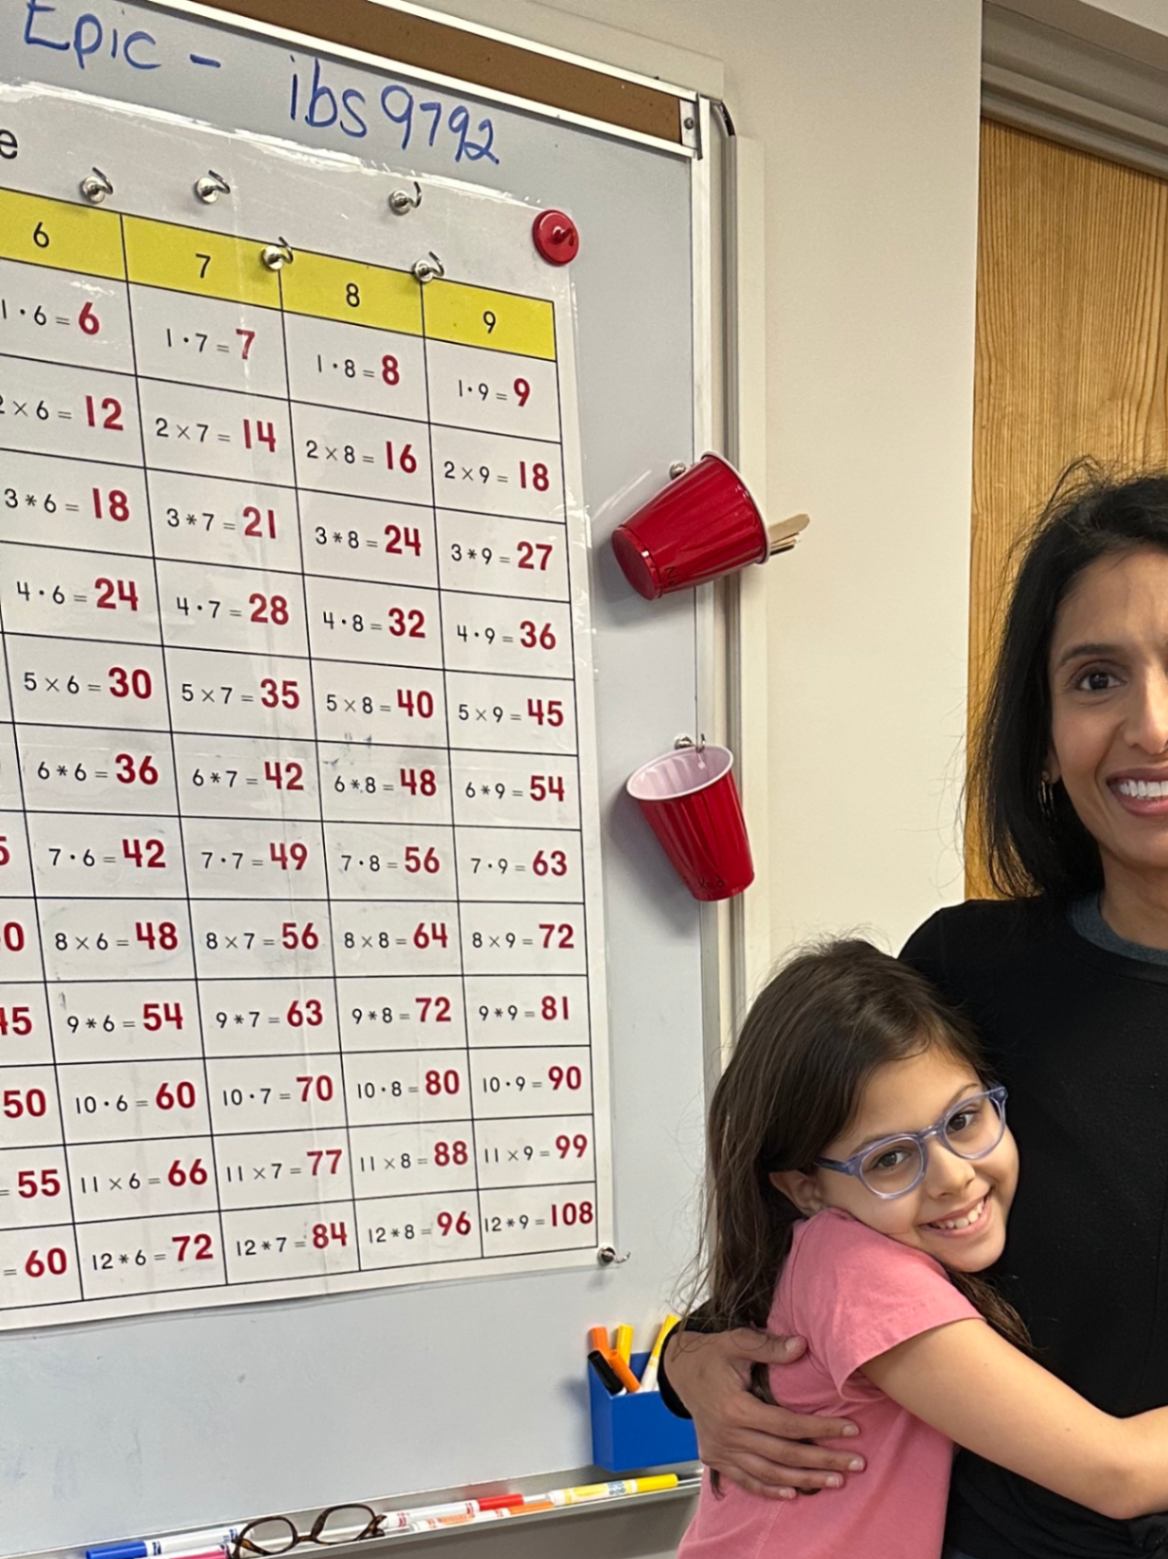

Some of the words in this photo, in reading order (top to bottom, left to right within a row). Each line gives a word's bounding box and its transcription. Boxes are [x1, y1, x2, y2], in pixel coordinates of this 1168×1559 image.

[33, 222, 50, 249] 6
[194, 253, 212, 280] 7
[345, 282, 361, 309] 8
[482, 310, 498, 335] 9
[235, 327, 257, 361] 7
[513, 377, 531, 406] 9
[243, 421, 276, 450] 14
[520, 463, 550, 493] 18
[243, 506, 276, 538] 21
[517, 541, 553, 570] 27
[249, 592, 289, 625] 28
[521, 620, 557, 650] 36
[261, 678, 300, 710] 35
[527, 699, 564, 728] 45
[264, 762, 303, 791] 42
[530, 775, 565, 801] 54
[532, 850, 568, 877] 63
[541, 923, 574, 949] 72
[541, 995, 569, 1021] 81
[548, 1065, 582, 1089] 90
[555, 1134, 588, 1157] 99
[551, 1201, 593, 1226] 108
